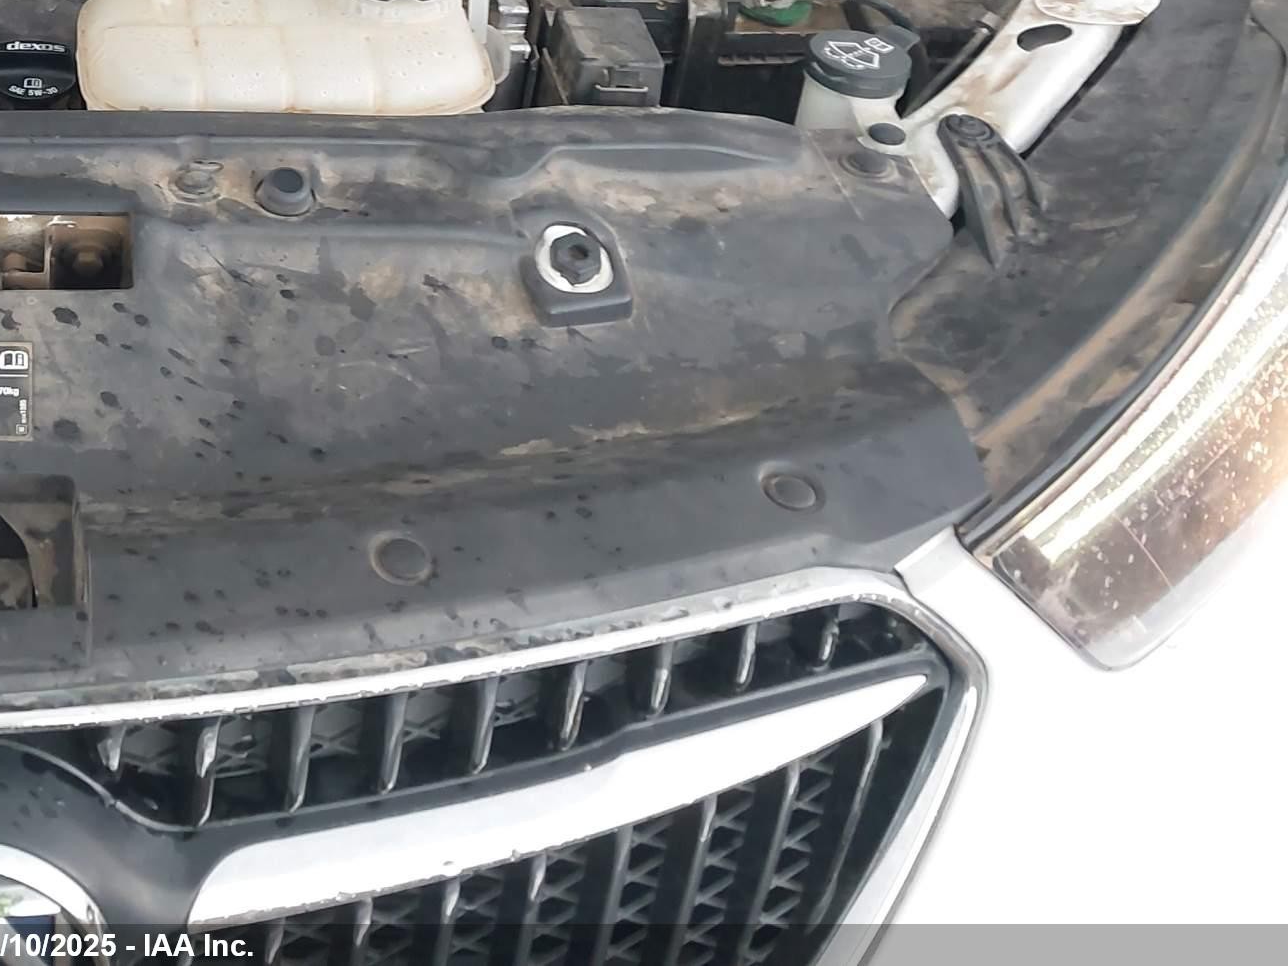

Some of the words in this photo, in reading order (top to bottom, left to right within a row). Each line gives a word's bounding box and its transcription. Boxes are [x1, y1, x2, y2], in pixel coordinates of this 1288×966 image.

[6, 41, 66, 52] dexos
[8, 85, 26, 95] SAE
[28, 86, 59, 96] 5W-30
